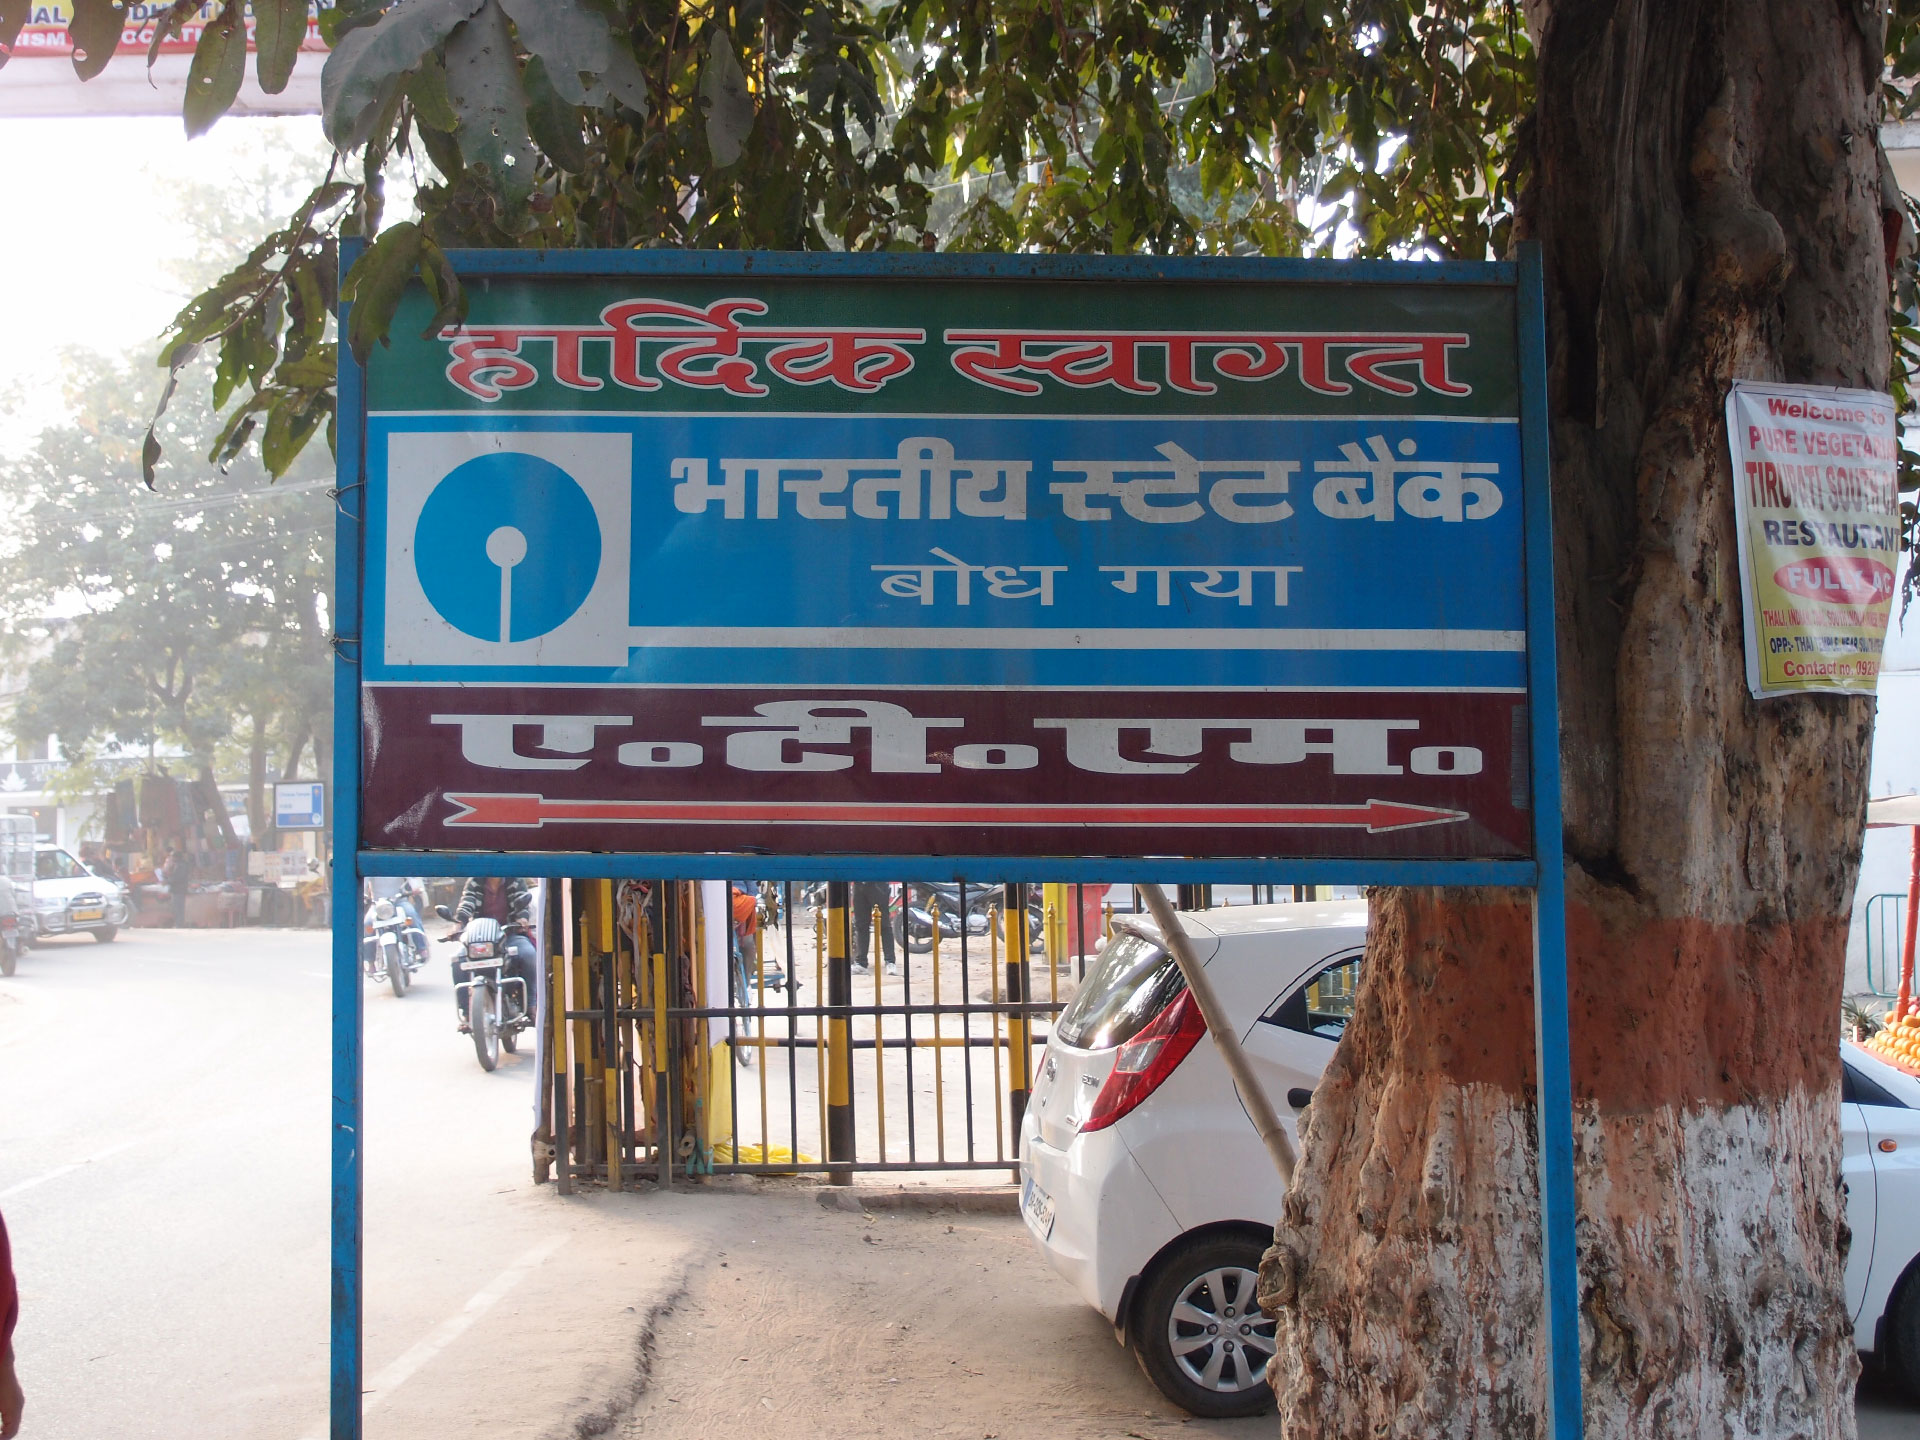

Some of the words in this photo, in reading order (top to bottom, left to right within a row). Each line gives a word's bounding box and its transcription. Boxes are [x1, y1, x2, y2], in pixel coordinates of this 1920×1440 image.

[438, 298, 926, 402] हार्दिक
[943, 329, 1472, 396] स्वागत
[1768, 398, 1866, 423] Welcome
[1871, 408, 1886, 426] to
[1748, 425, 1798, 454] PURE
[1803, 431, 1897, 462] VEGETARIA
[670, 436, 1032, 520] भारतीय
[1049, 440, 1301, 524] स्टेट
[1313, 434, 1503, 522] बैंक
[1744, 461, 1825, 512] TIRUPATI
[1763, 519, 1900, 553] RESTAURANT
[871, 546, 1068, 606] बोध
[1099, 565, 1303, 606] गया
[1787, 567, 1865, 591] FULLY
[1872, 570, 1892, 594] AC
[1783, 660, 1837, 677] Contact
